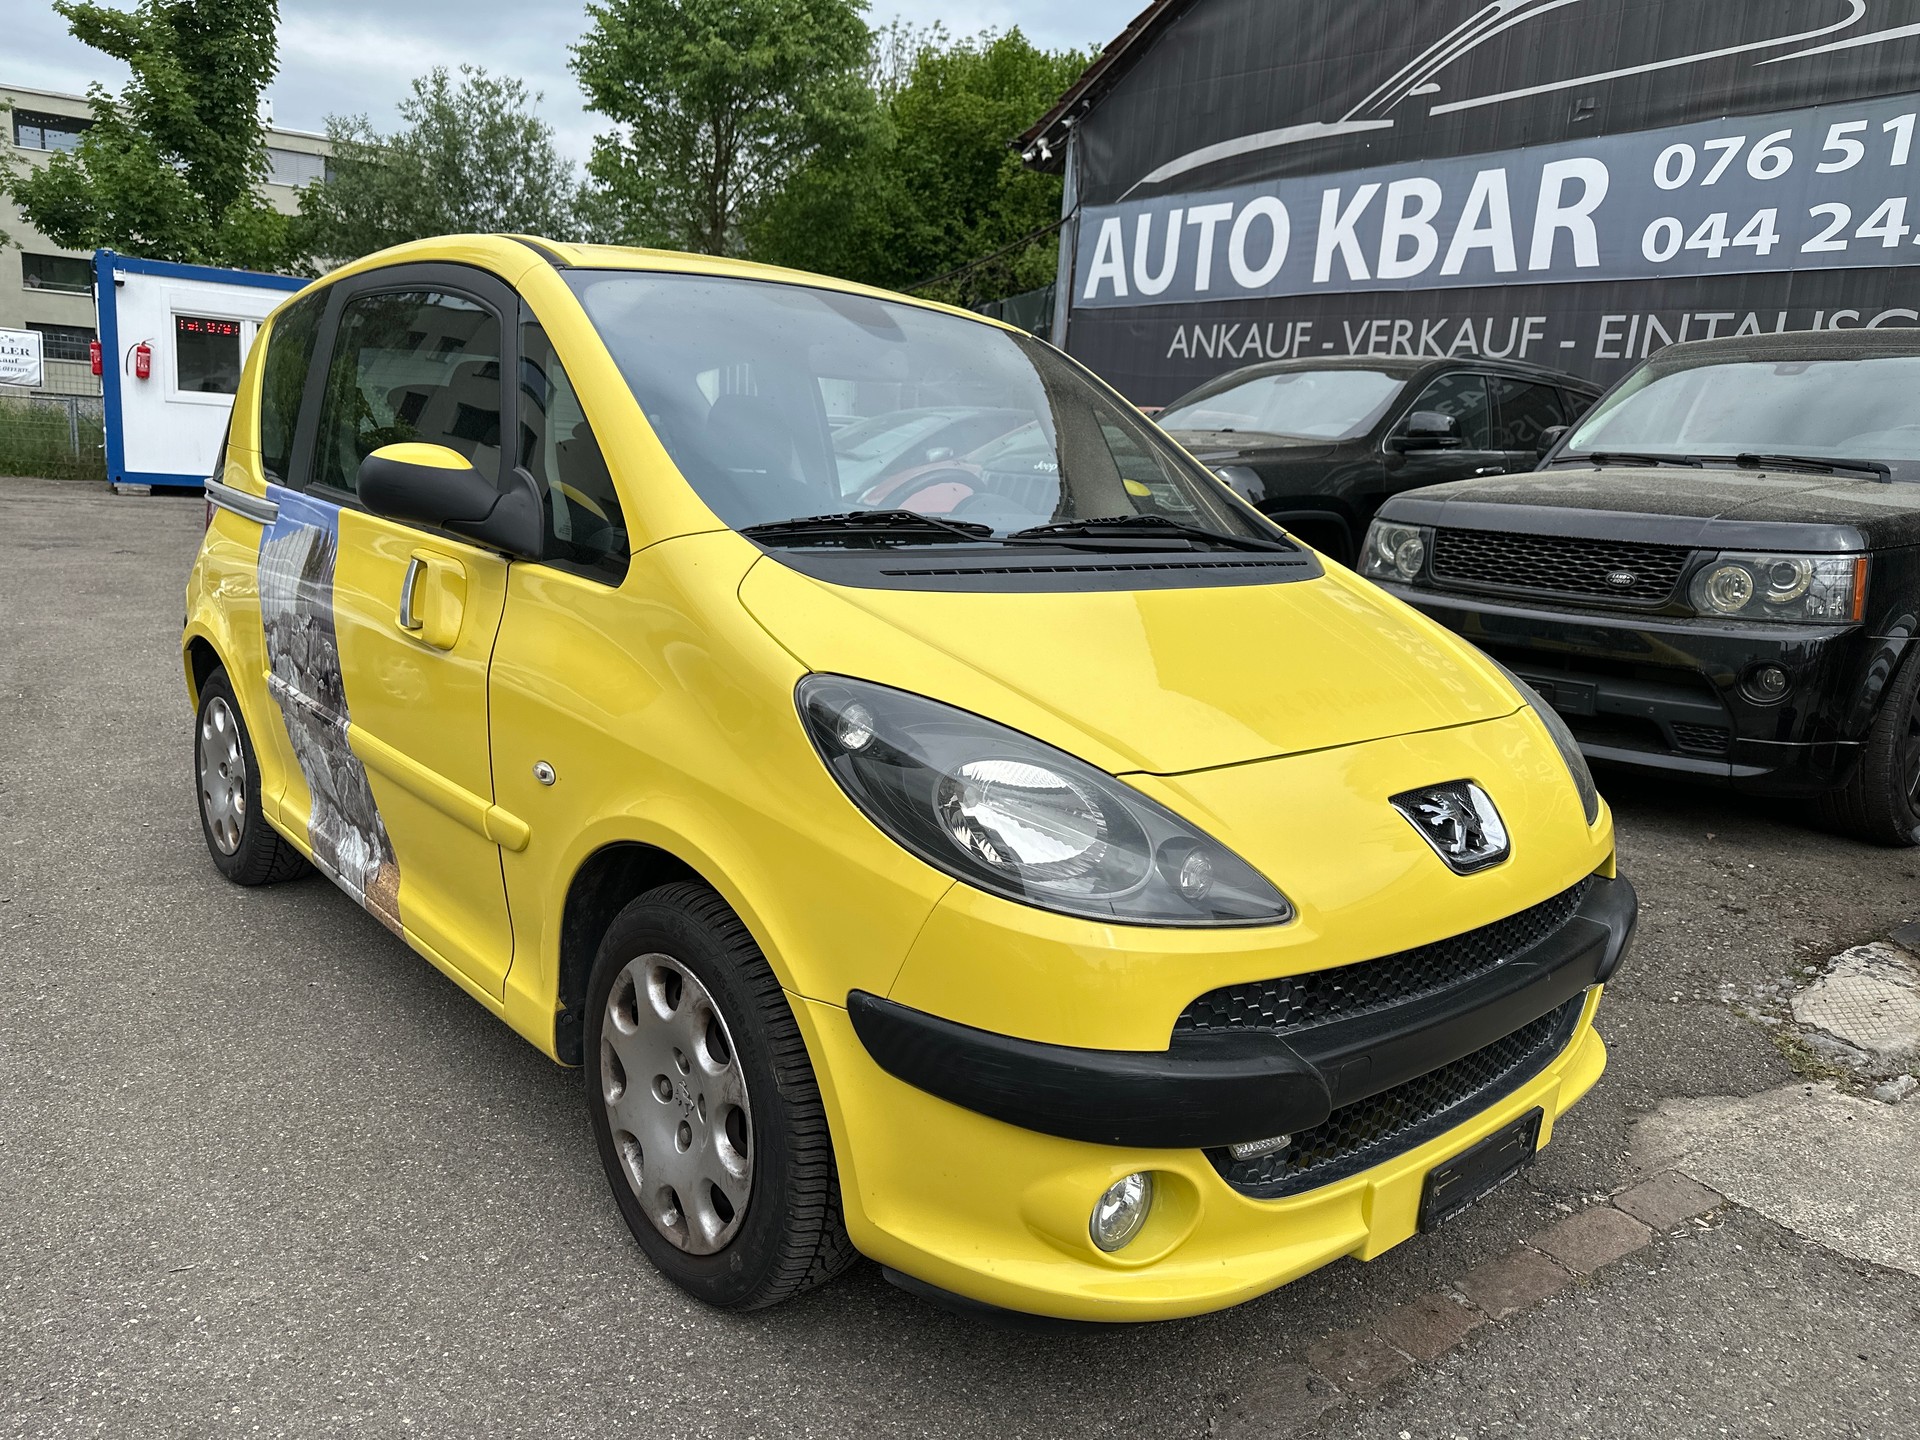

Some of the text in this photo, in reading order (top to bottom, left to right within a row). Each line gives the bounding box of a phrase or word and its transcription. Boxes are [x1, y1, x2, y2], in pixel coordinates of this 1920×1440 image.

[1653, 113, 1917, 191] 076 51
[1083, 156, 1610, 299] AUTO KBAR
[1641, 196, 1920, 262] 044 24
[1166, 321, 1313, 359] ANKAUF
[1343, 316, 1547, 357] VERKAUF
[1033, 460, 1058, 472] Jeep
